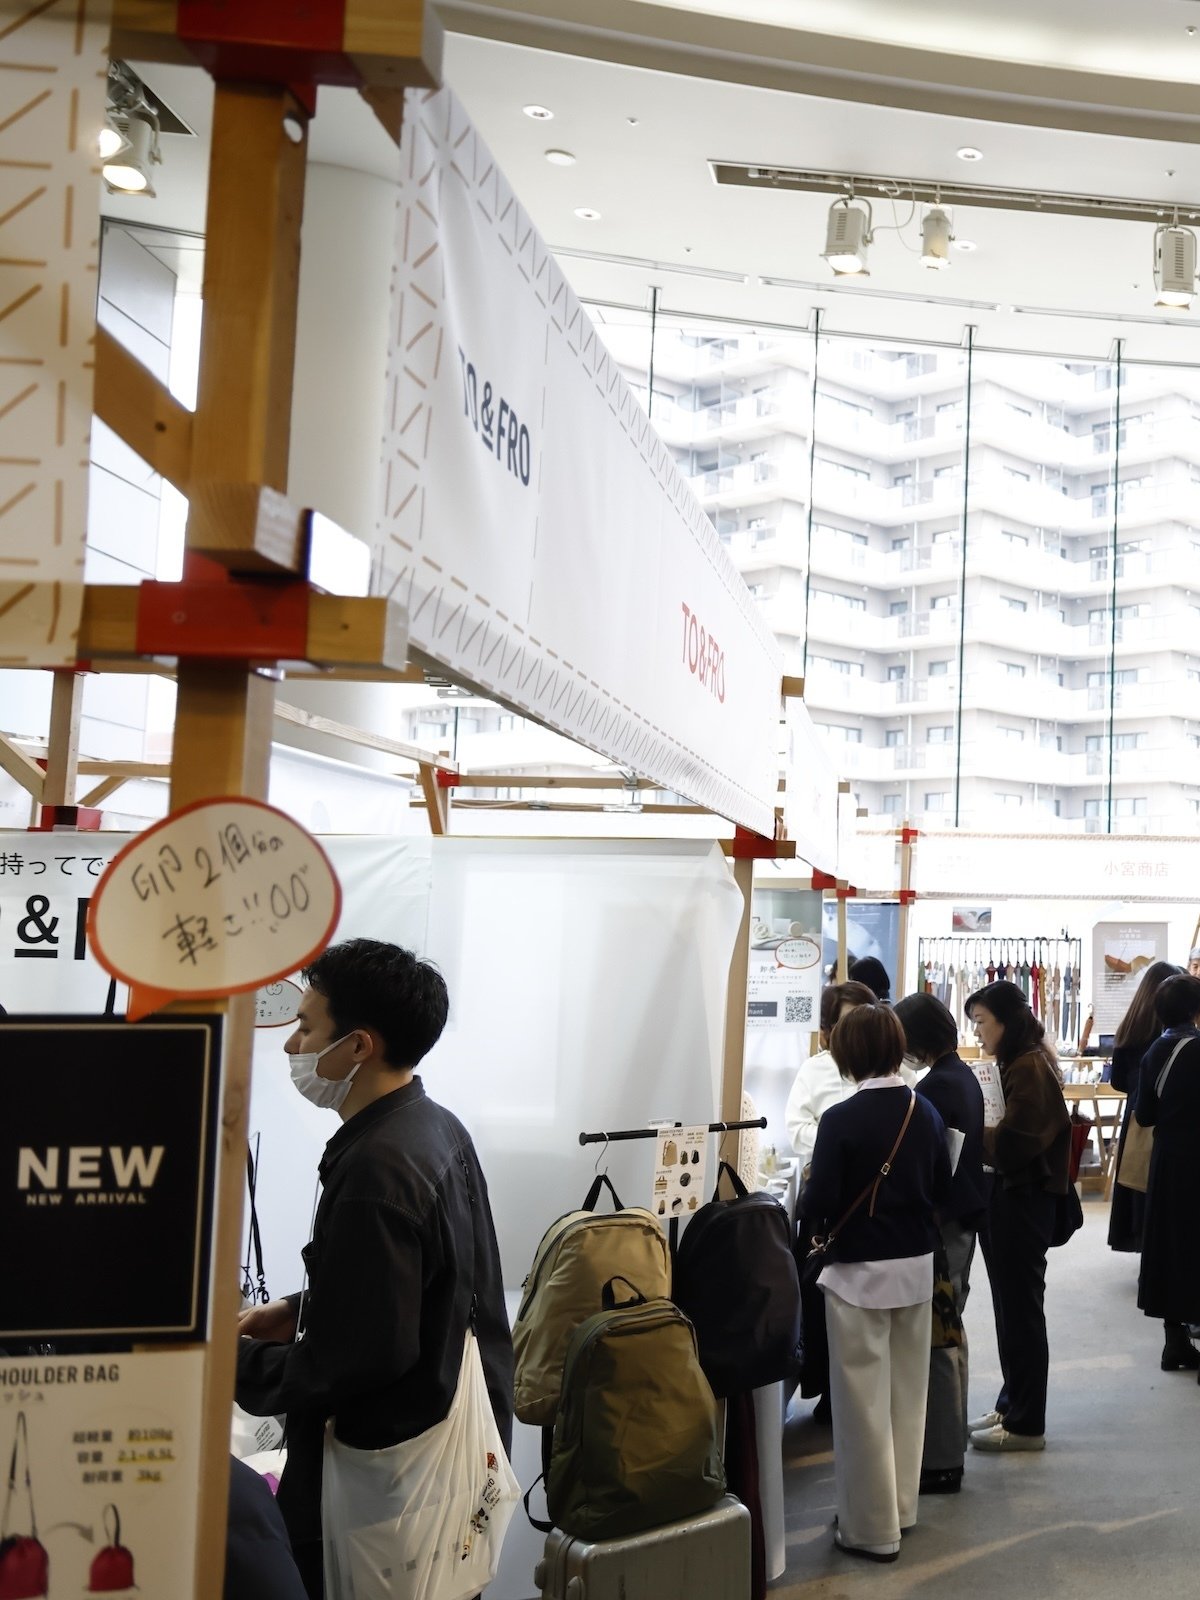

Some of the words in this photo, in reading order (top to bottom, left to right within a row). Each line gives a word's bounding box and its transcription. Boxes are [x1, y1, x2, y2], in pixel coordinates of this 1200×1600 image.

[682, 601, 725, 703] TO&FRO
[0, 853, 113, 877] 持ってで
[1104, 860, 1170, 878] 小宮商店
[17, 1145, 165, 1190] NEW
[26, 1193, 62, 1205] NEW
[75, 1192, 146, 1205] ARRIVAL
[84, 1364, 119, 1383] BAG
